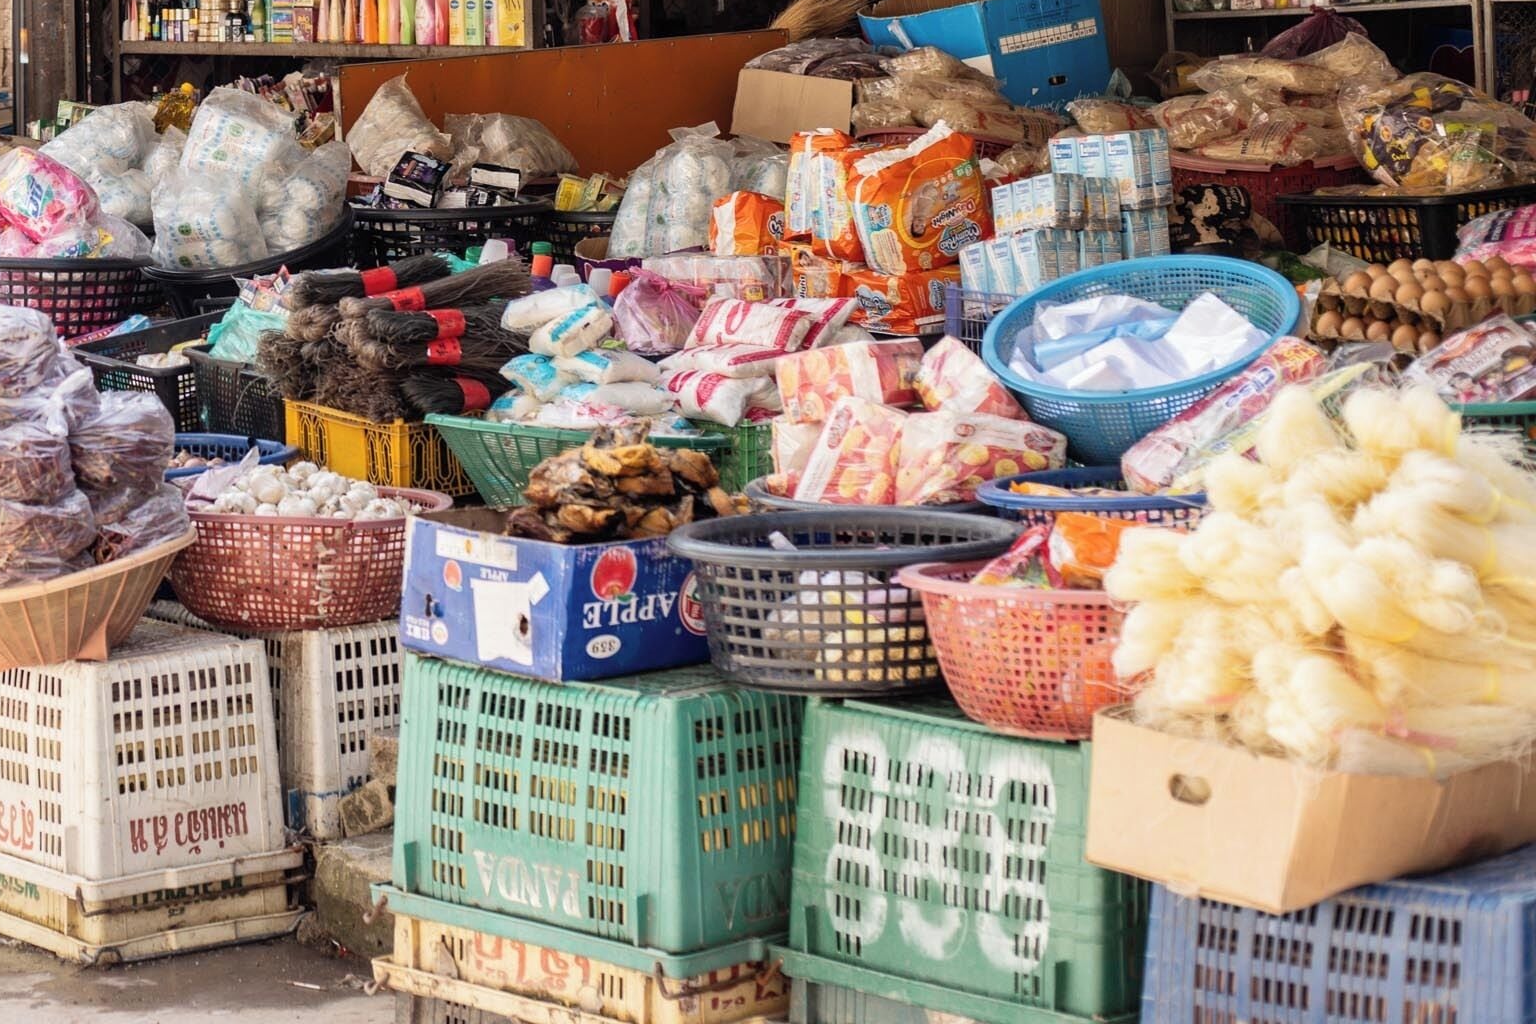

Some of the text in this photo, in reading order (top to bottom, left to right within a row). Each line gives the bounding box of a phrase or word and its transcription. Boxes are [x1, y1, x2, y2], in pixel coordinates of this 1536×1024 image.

[583, 591, 678, 629] APPLE
[591, 639, 616, 654] 359
[473, 850, 582, 919] PANDA
